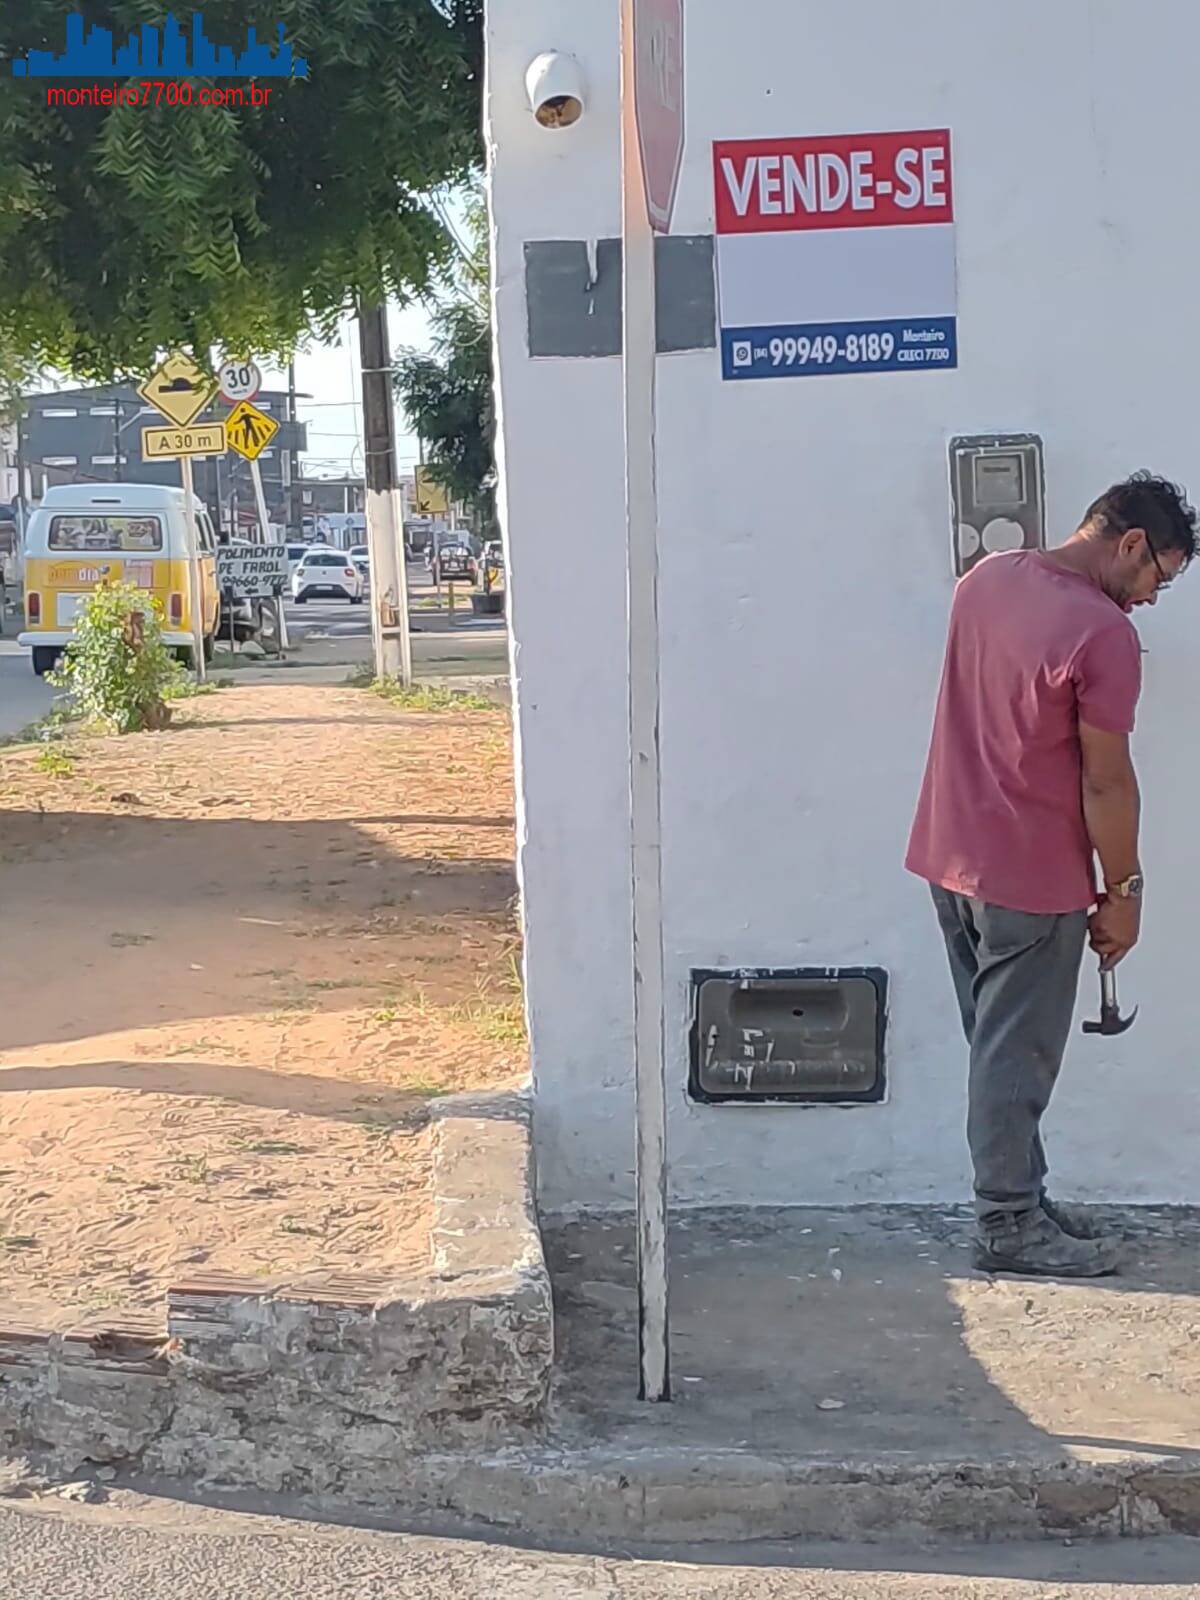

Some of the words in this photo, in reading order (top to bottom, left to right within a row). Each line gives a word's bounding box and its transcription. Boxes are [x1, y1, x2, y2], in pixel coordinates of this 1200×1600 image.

[720, 147, 947, 216] VENDE-SE
[903, 328, 946, 342] Monteiro
[769, 333, 895, 366] 99949-8189
[225, 367, 250, 388] 30
[158, 435, 171, 450] A
[175, 434, 193, 449] 30
[198, 435, 212, 448] m
[217, 545, 286, 560] POLIMENTO
[218, 562, 235, 575] DE
[242, 561, 282, 574] FAROL
